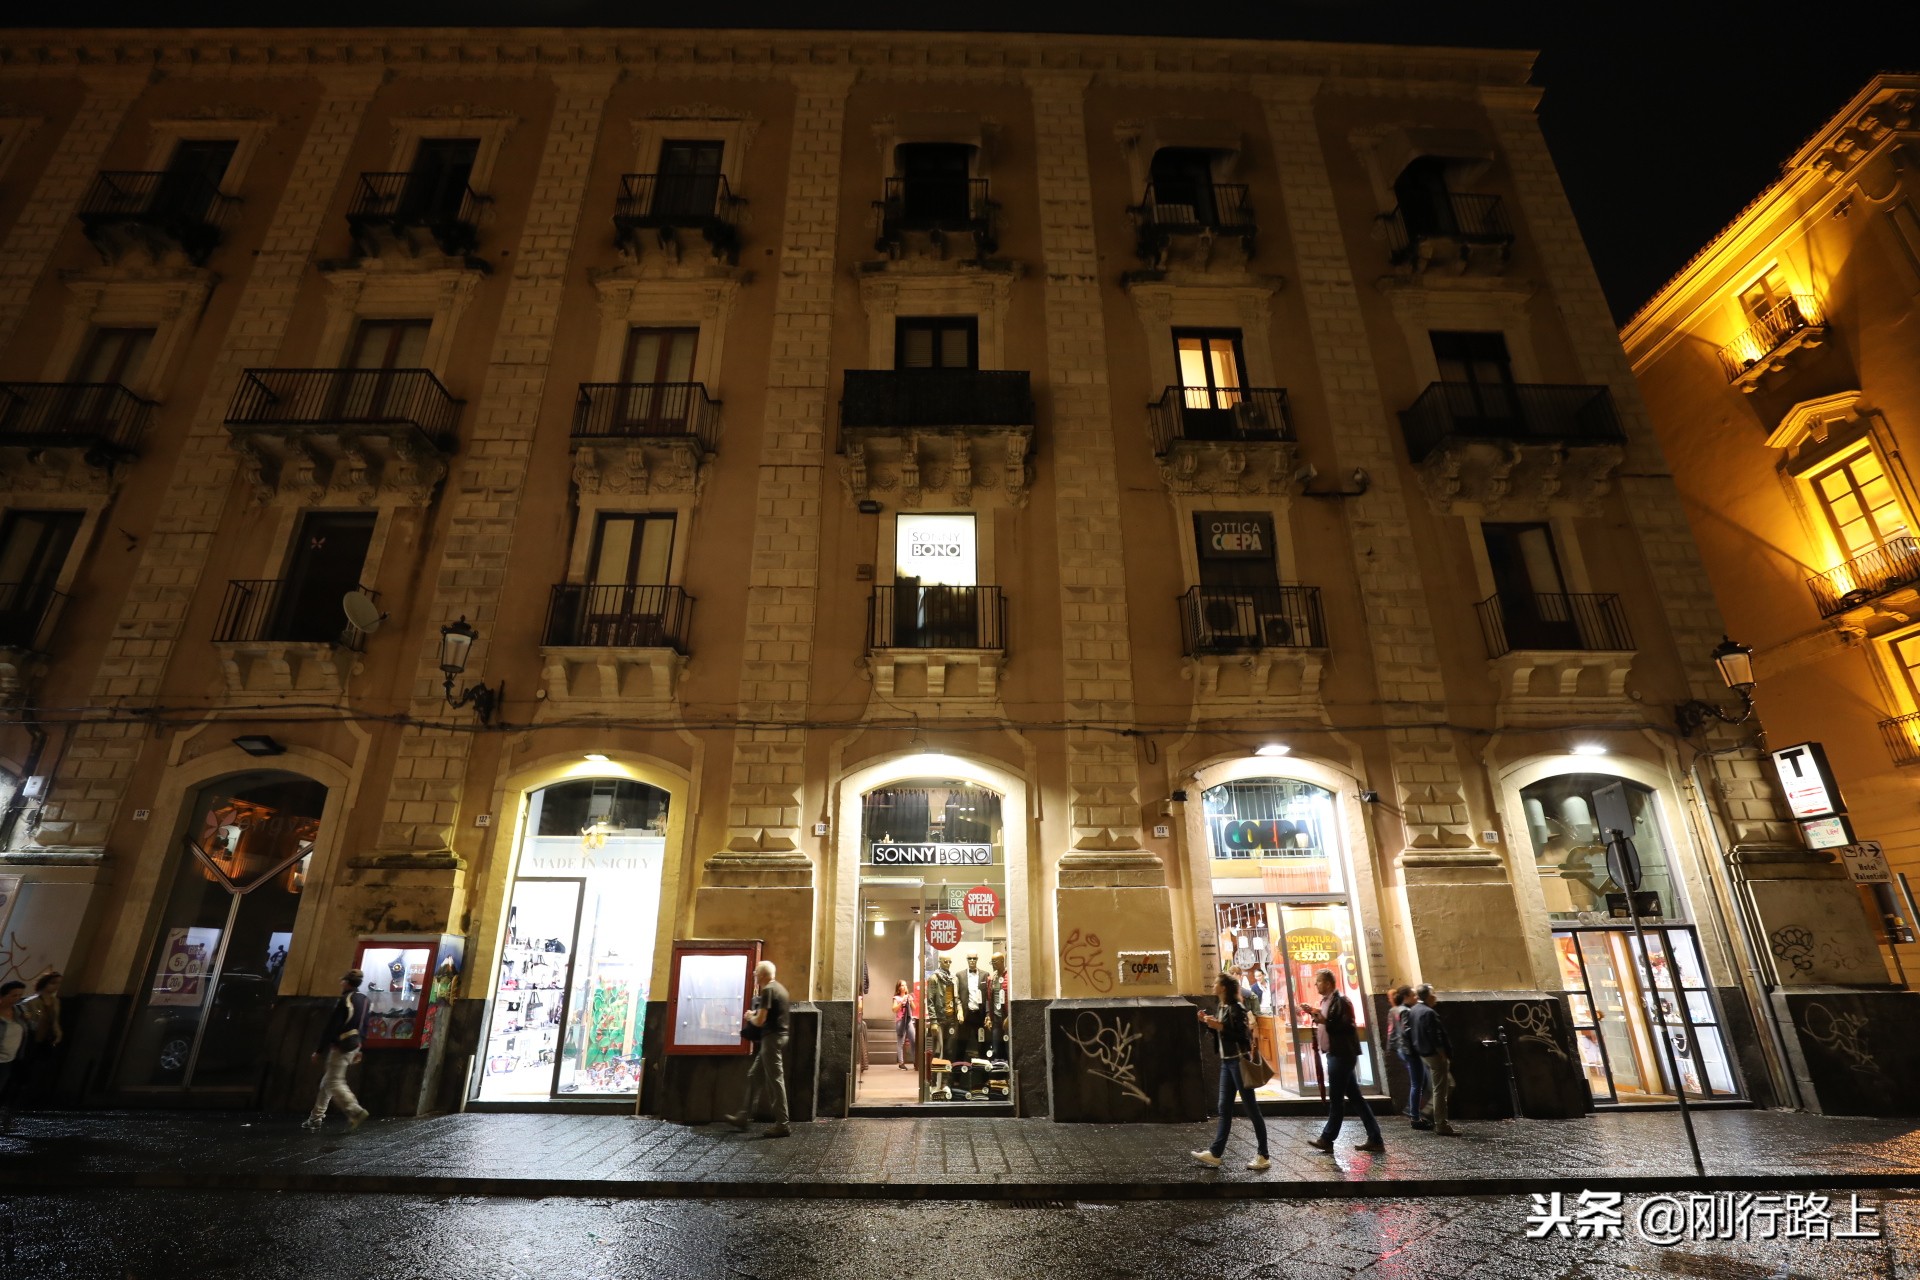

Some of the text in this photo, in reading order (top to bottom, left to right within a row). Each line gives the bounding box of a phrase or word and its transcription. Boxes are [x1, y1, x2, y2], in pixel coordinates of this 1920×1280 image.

[1211, 522, 1261, 534] OTTICA
[912, 531, 961, 542] SONNY
[912, 544, 960, 556] BONO
[1779, 748, 1804, 778] T
[876, 847, 988, 864] SONNY BONO
[533, 857, 651, 869] MADE IN SICILY
[1857, 863, 1878, 871] Hotel
[967, 893, 995, 904] SPECIAL
[967, 904, 995, 917] WEEK
[930, 920, 957, 931] SPECIAL
[930, 931, 957, 944] PRICE
[1286, 935, 1337, 944] MONTATURA
[1300, 943, 1323, 951] LENTI
